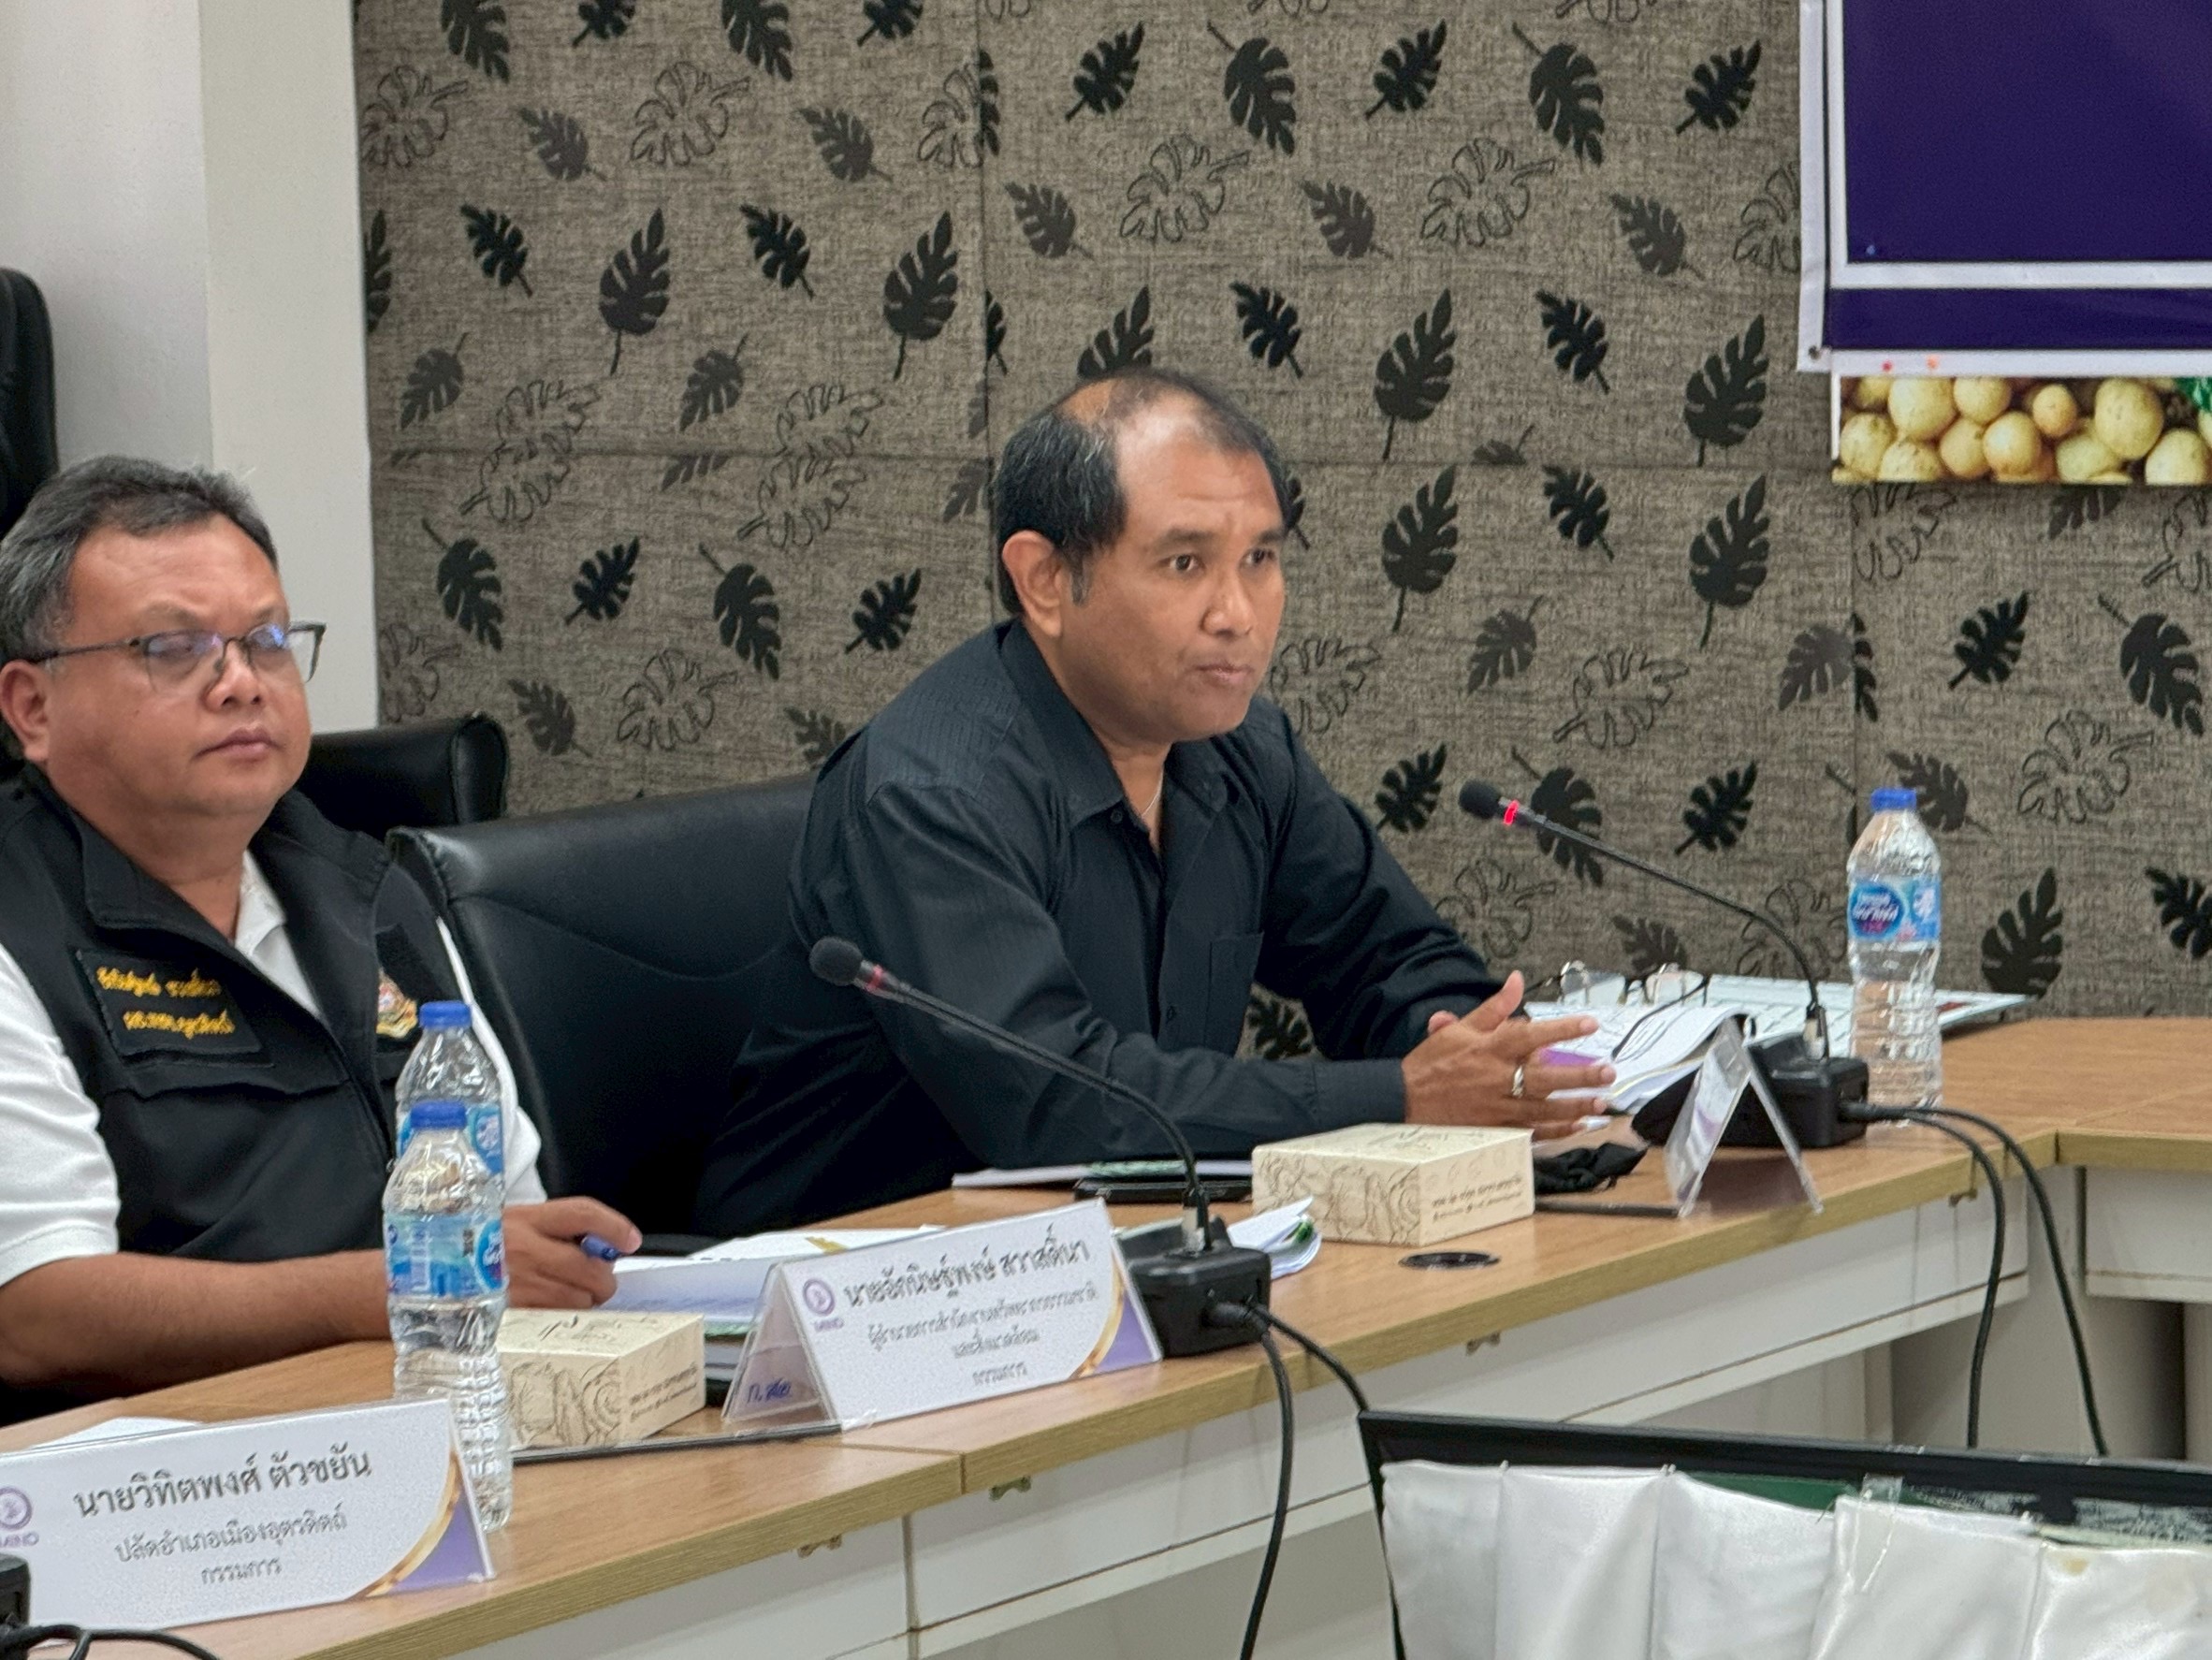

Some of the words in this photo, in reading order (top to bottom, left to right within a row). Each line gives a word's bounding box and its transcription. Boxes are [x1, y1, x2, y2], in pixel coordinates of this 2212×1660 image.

[73, 1452, 263, 1518] นายวิทิตพงศ์
[268, 1440, 372, 1491] ตัวขยัน
[114, 1500, 348, 1563] ปลัดอำเภอเมืองอุตรดิตถ์
[200, 1556, 282, 1585] กรรมการ
